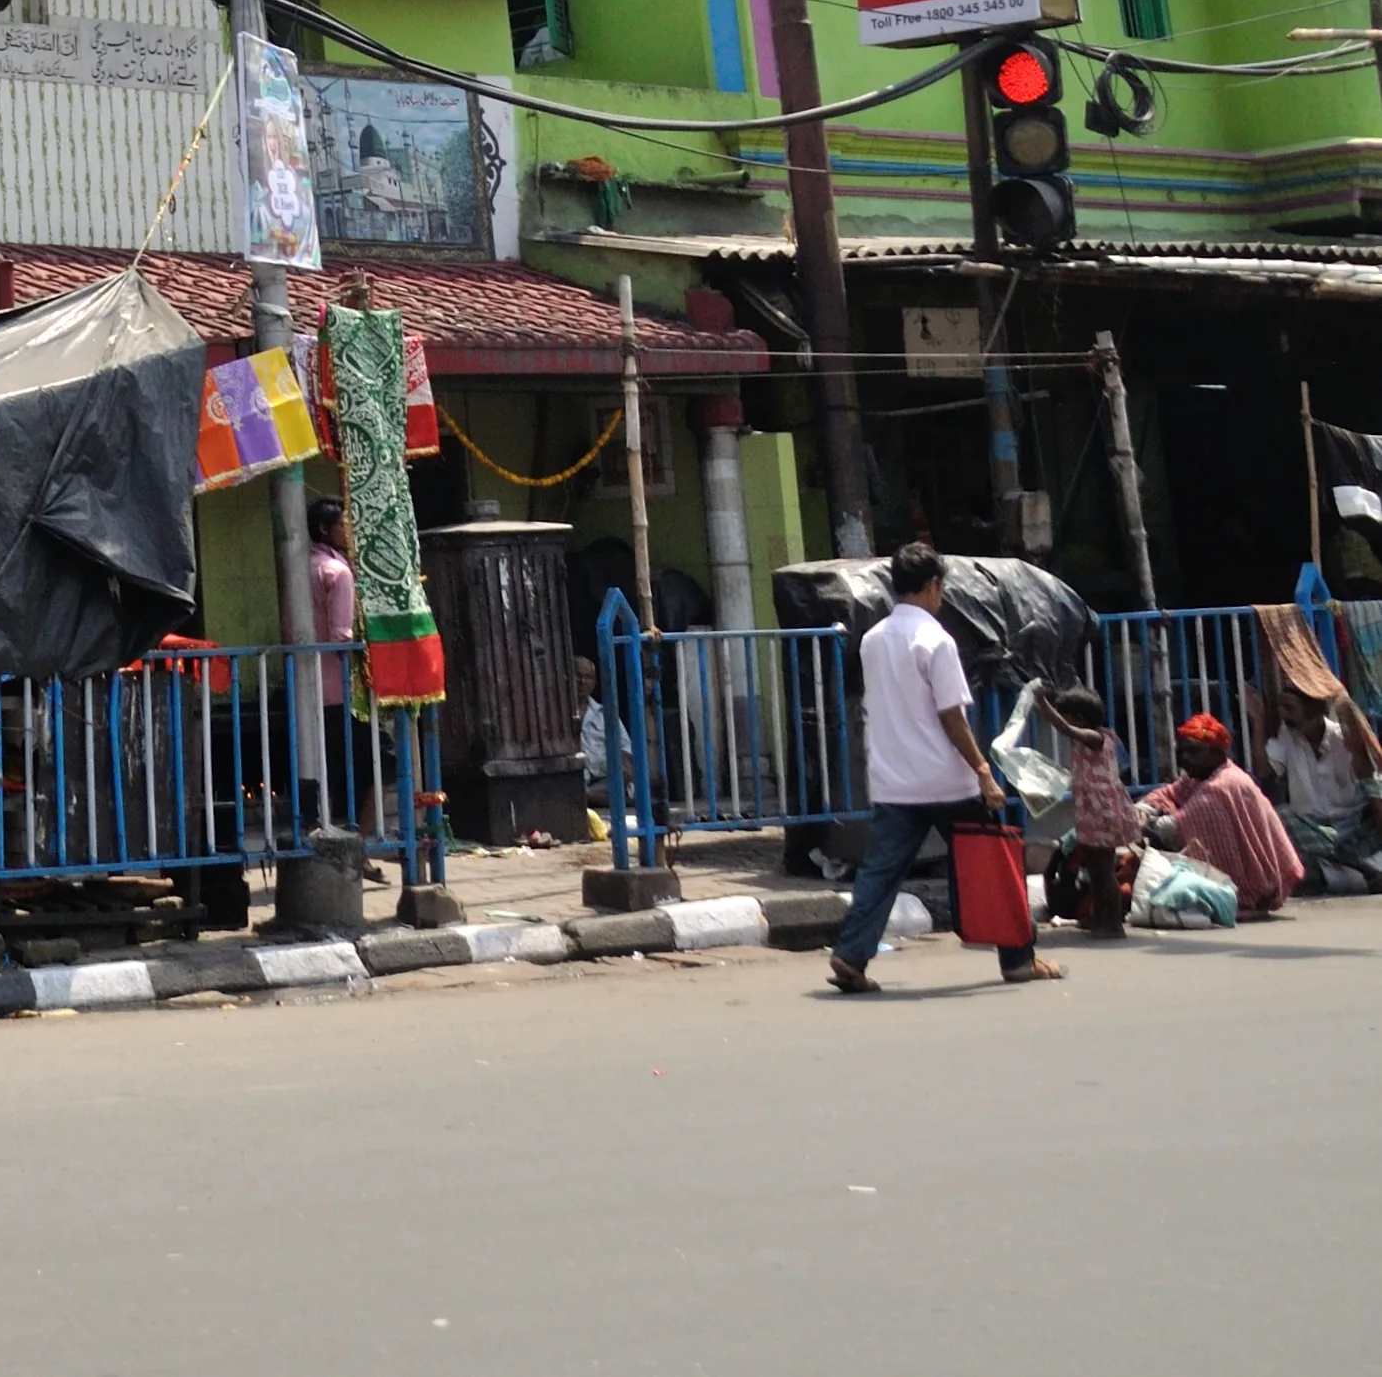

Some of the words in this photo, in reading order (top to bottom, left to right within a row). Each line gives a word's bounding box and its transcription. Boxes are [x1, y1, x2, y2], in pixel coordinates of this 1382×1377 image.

[871, 17, 892, 30] Toll
[895, 14, 922, 27] Free
[926, 7, 954, 21] 1800
[957, 2, 980, 17] 345
